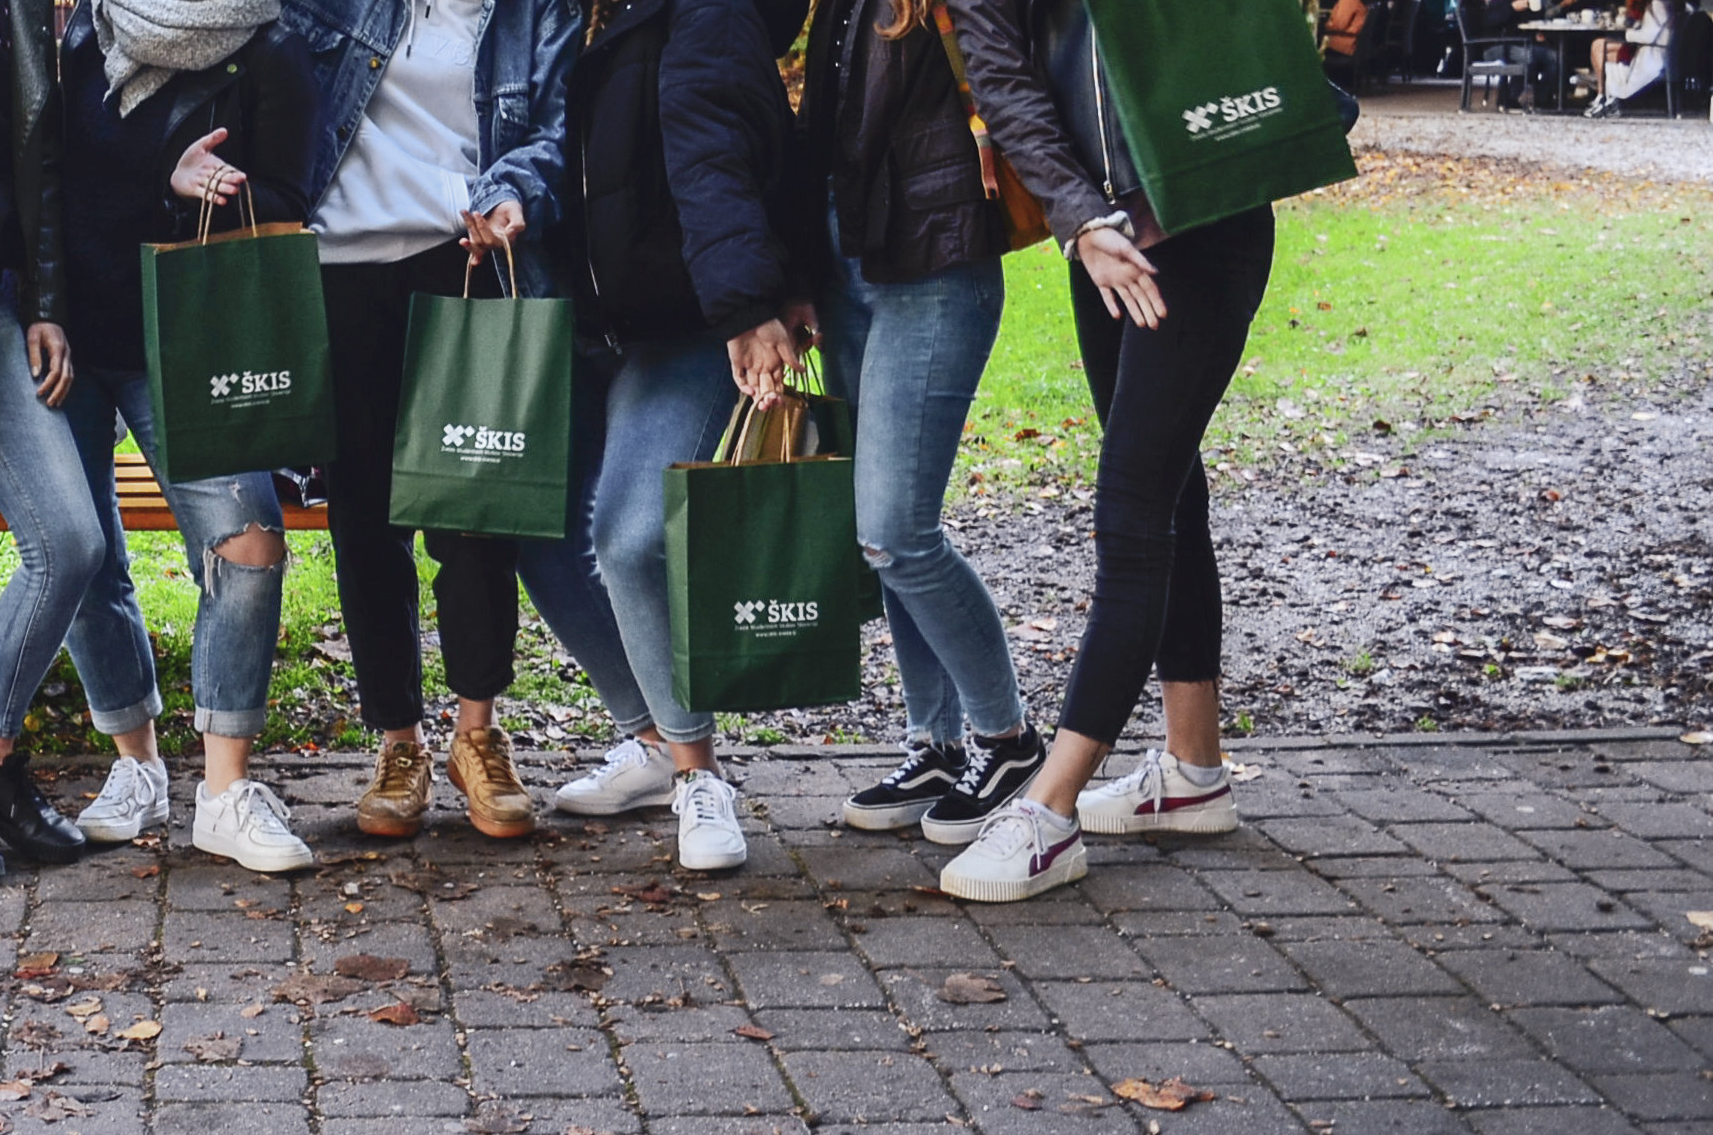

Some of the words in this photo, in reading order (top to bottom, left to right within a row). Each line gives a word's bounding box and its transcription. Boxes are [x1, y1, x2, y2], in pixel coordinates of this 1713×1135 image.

[1219, 86, 1281, 122] ŠKIS
[241, 370, 292, 394] ŠKIS
[474, 425, 526, 452] ŠKIS
[767, 599, 819, 623] ŠKIS
